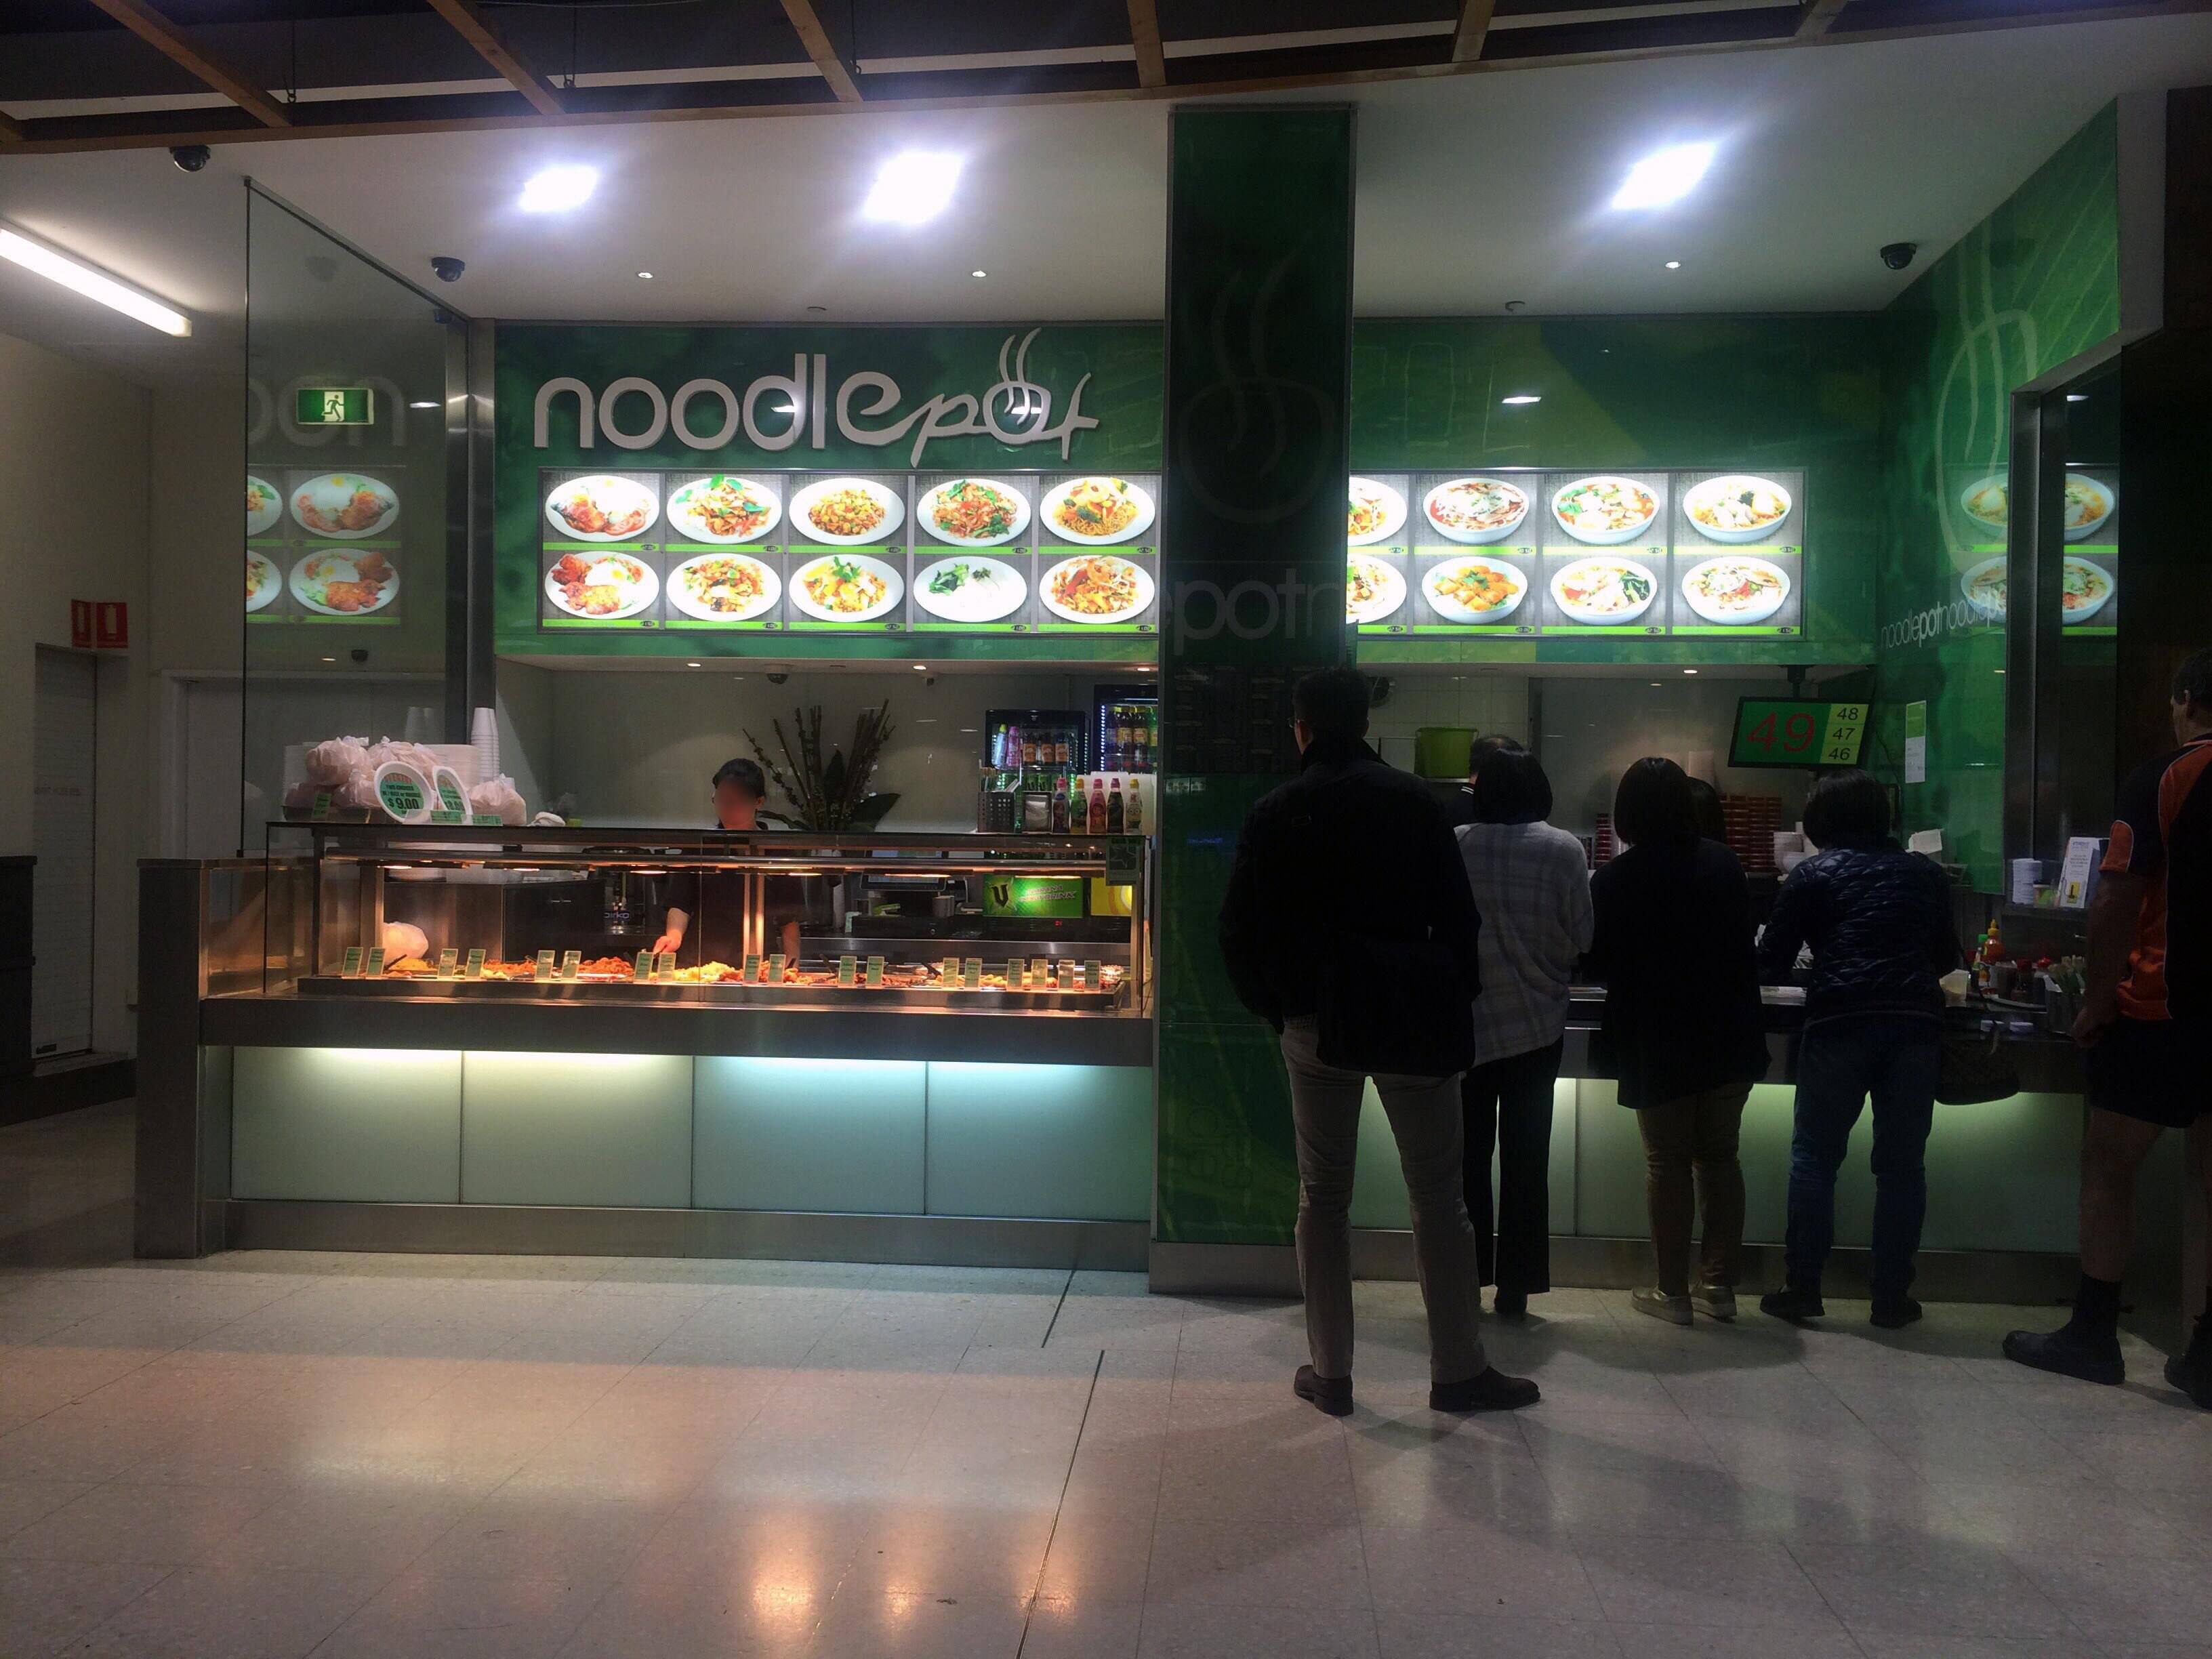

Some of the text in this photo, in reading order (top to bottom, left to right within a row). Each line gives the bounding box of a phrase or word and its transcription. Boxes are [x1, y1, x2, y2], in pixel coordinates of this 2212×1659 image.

[1837, 708, 1858, 720] 48
[1746, 711, 1815, 752] 49
[1832, 727, 1856, 741] 47
[1828, 747, 1850, 760] 46
[991, 883, 1008, 908] V
